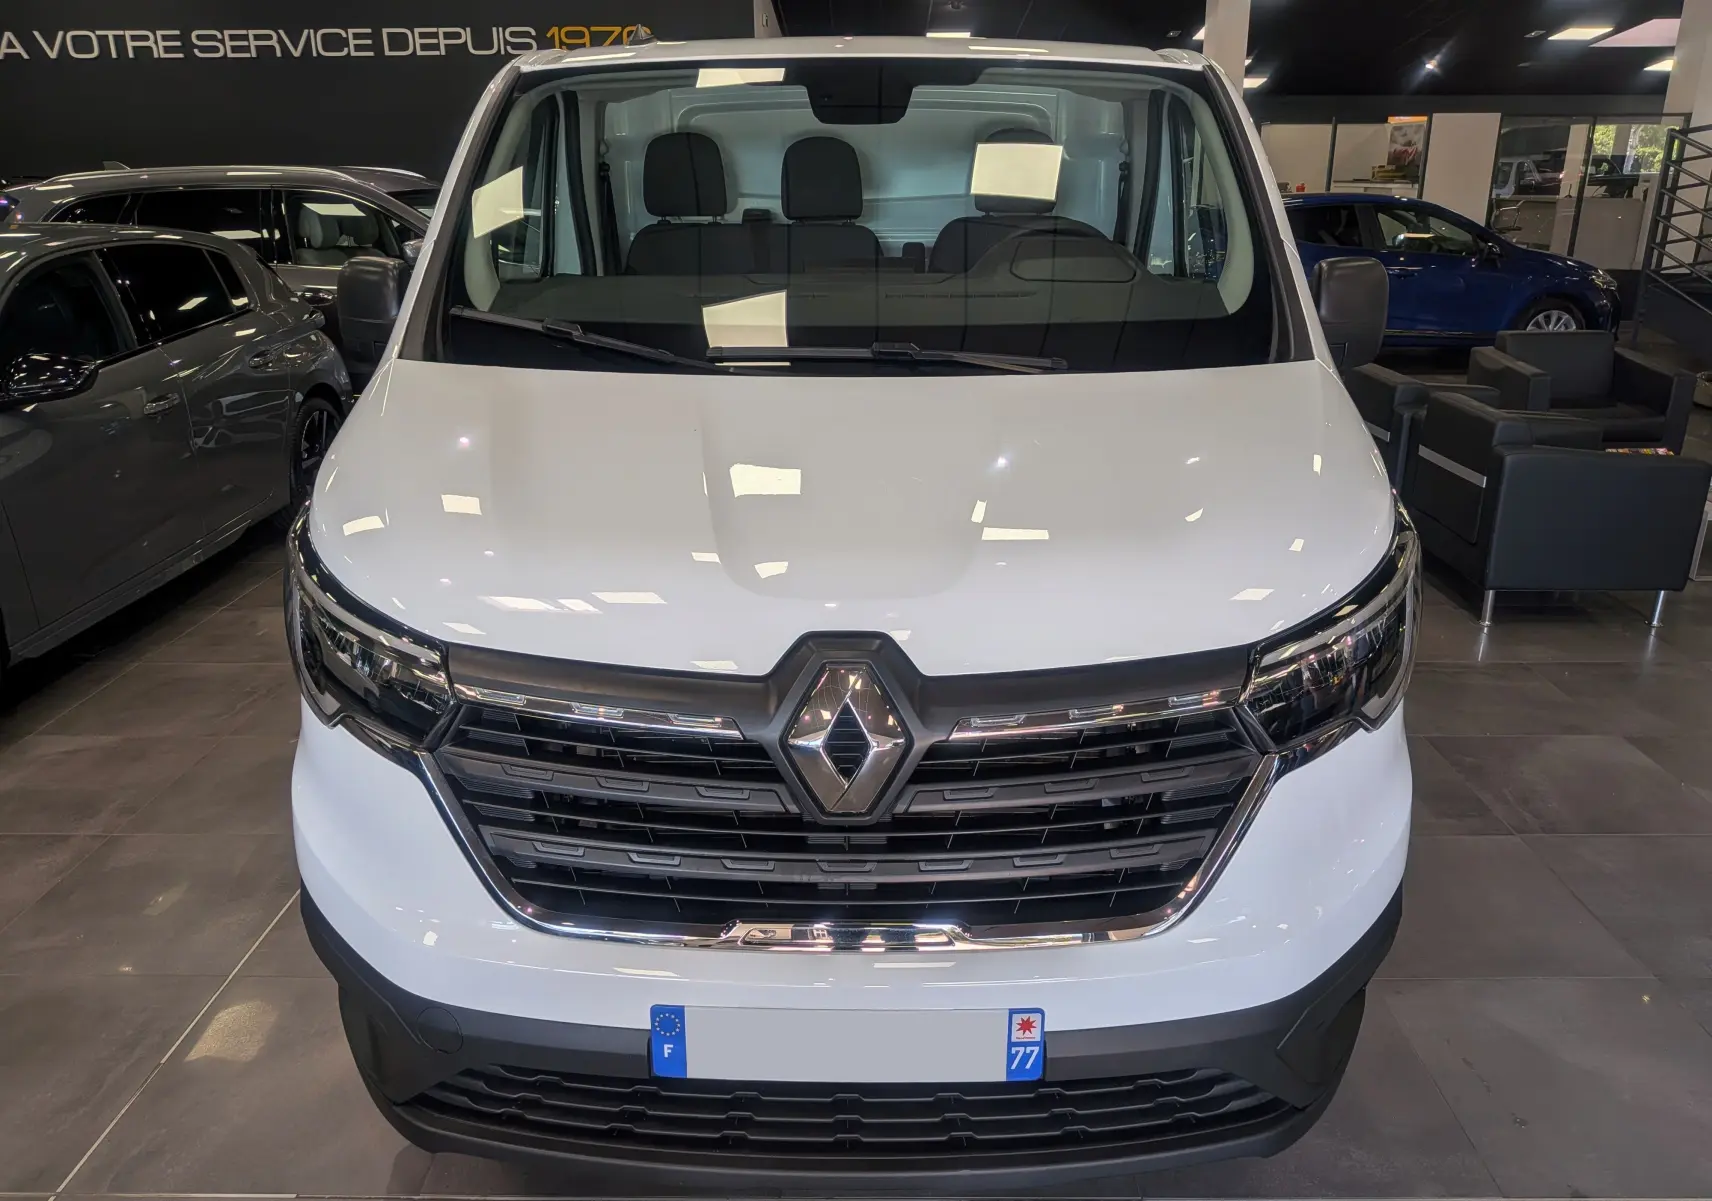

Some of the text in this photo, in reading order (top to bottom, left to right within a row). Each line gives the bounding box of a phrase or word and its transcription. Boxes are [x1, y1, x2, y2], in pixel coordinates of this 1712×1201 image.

[0, 31, 30, 60] A
[32, 30, 185, 59] VOTRE
[191, 28, 375, 58] SERVICE
[382, 26, 538, 56] DEPUIS
[663, 1043, 674, 1058] F
[1010, 1046, 1040, 1070] 77
